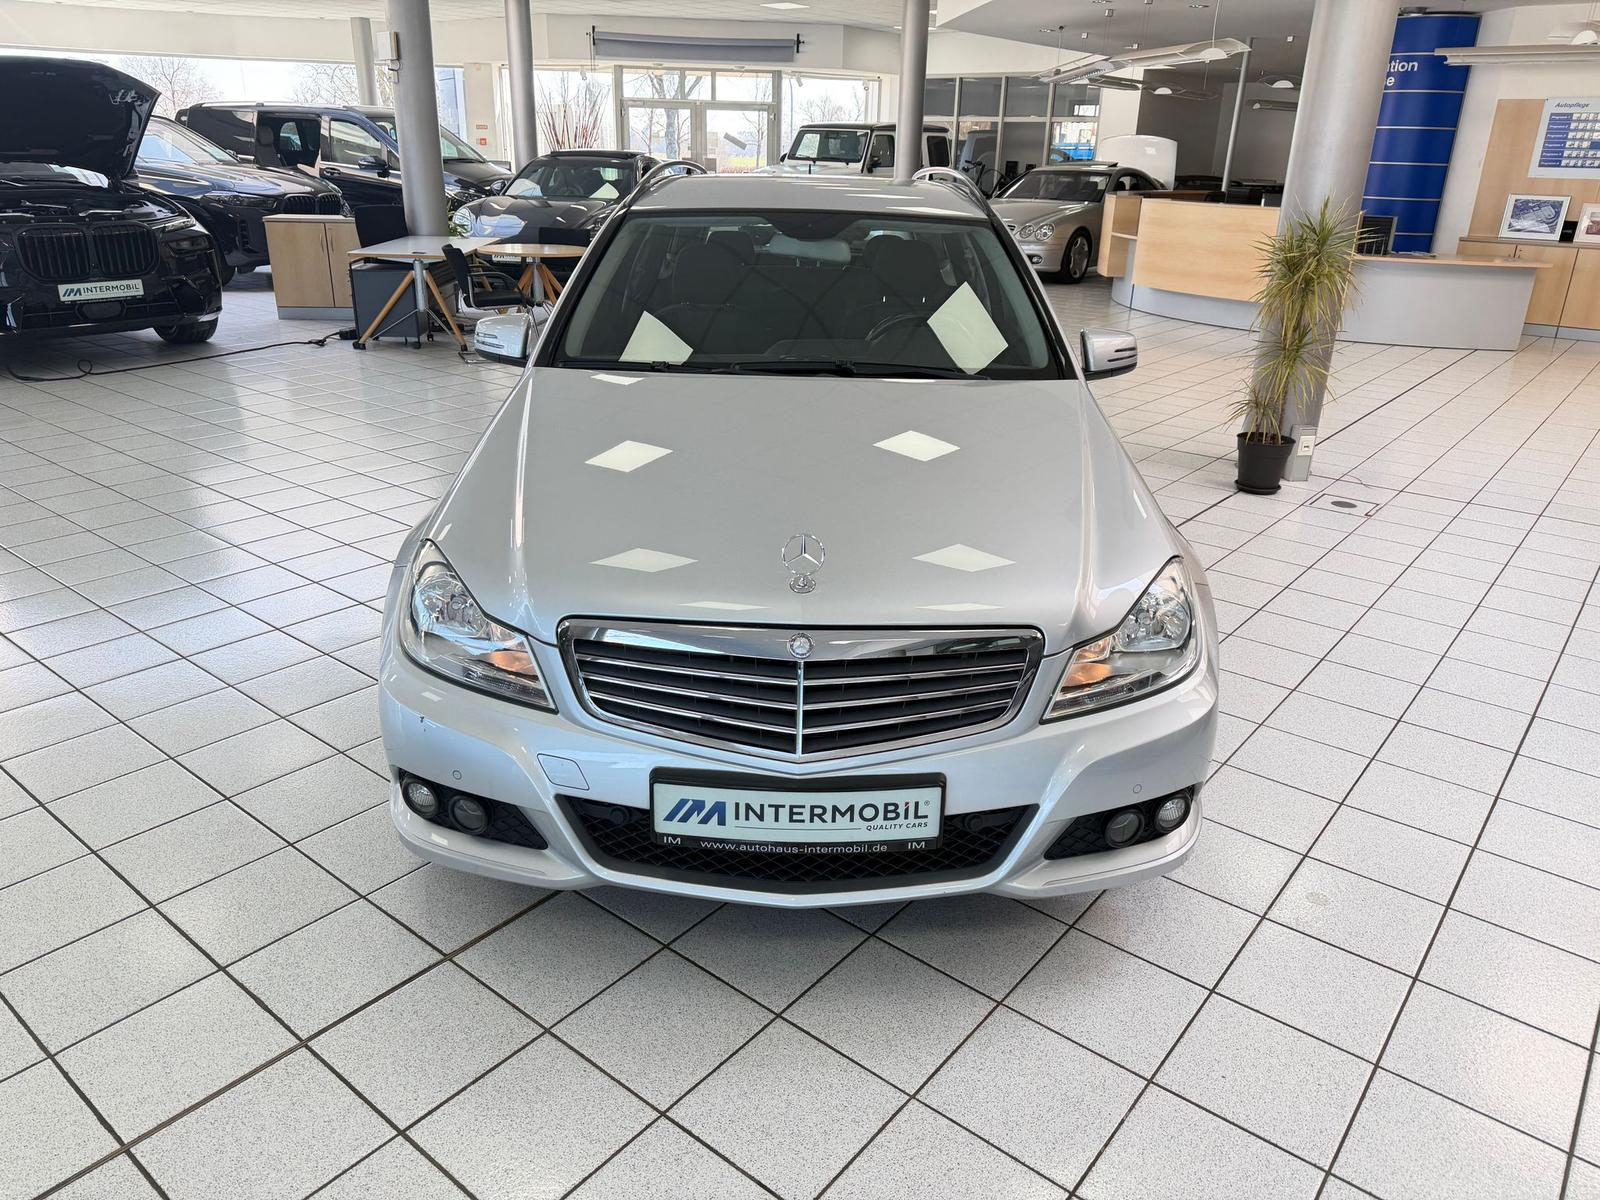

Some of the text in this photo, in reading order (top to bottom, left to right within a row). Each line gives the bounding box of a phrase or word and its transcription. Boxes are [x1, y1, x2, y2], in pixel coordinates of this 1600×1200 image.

[865, 821, 928, 832] QUALITY CARS
[663, 836, 926, 854] IM www.autohaus-intermobil.de IM
